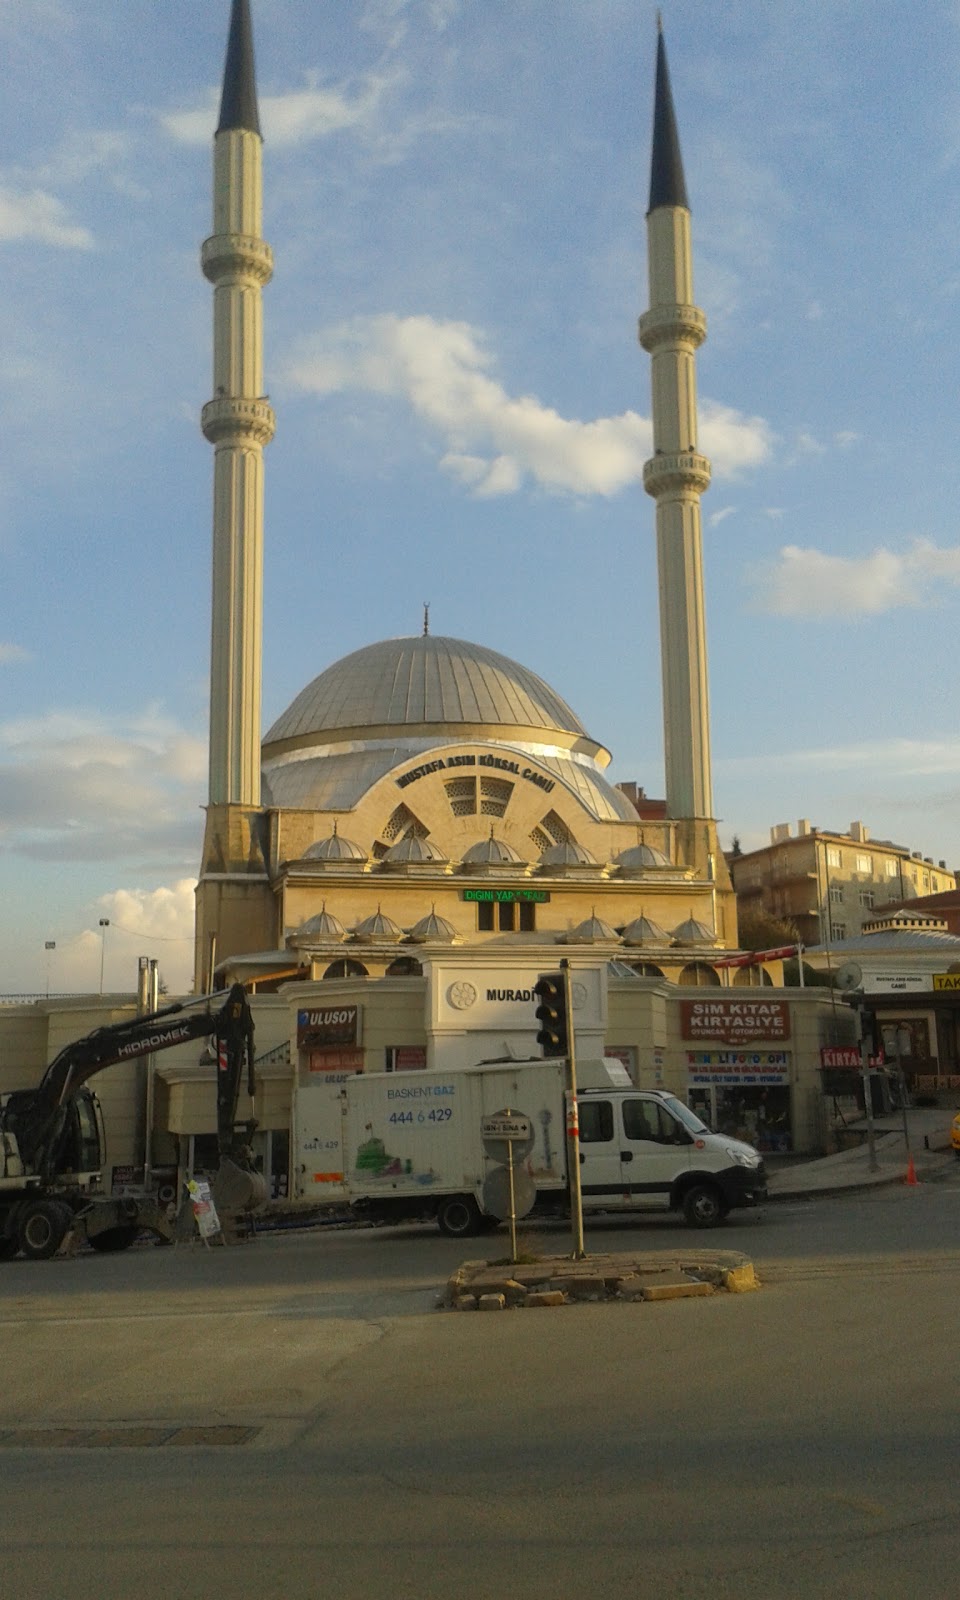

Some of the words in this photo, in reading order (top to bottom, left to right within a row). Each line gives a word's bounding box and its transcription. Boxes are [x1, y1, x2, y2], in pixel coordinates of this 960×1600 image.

[396, 759, 447, 789] MUSTAFA
[447, 754, 476, 768] ASIM
[478, 754, 520, 775] KÖKSAL
[310, 1010, 355, 1026] ULUSOY
[389, 1112, 413, 1124] 444
[417, 1111, 425, 1123] 6
[428, 1108, 452, 1122] 429
